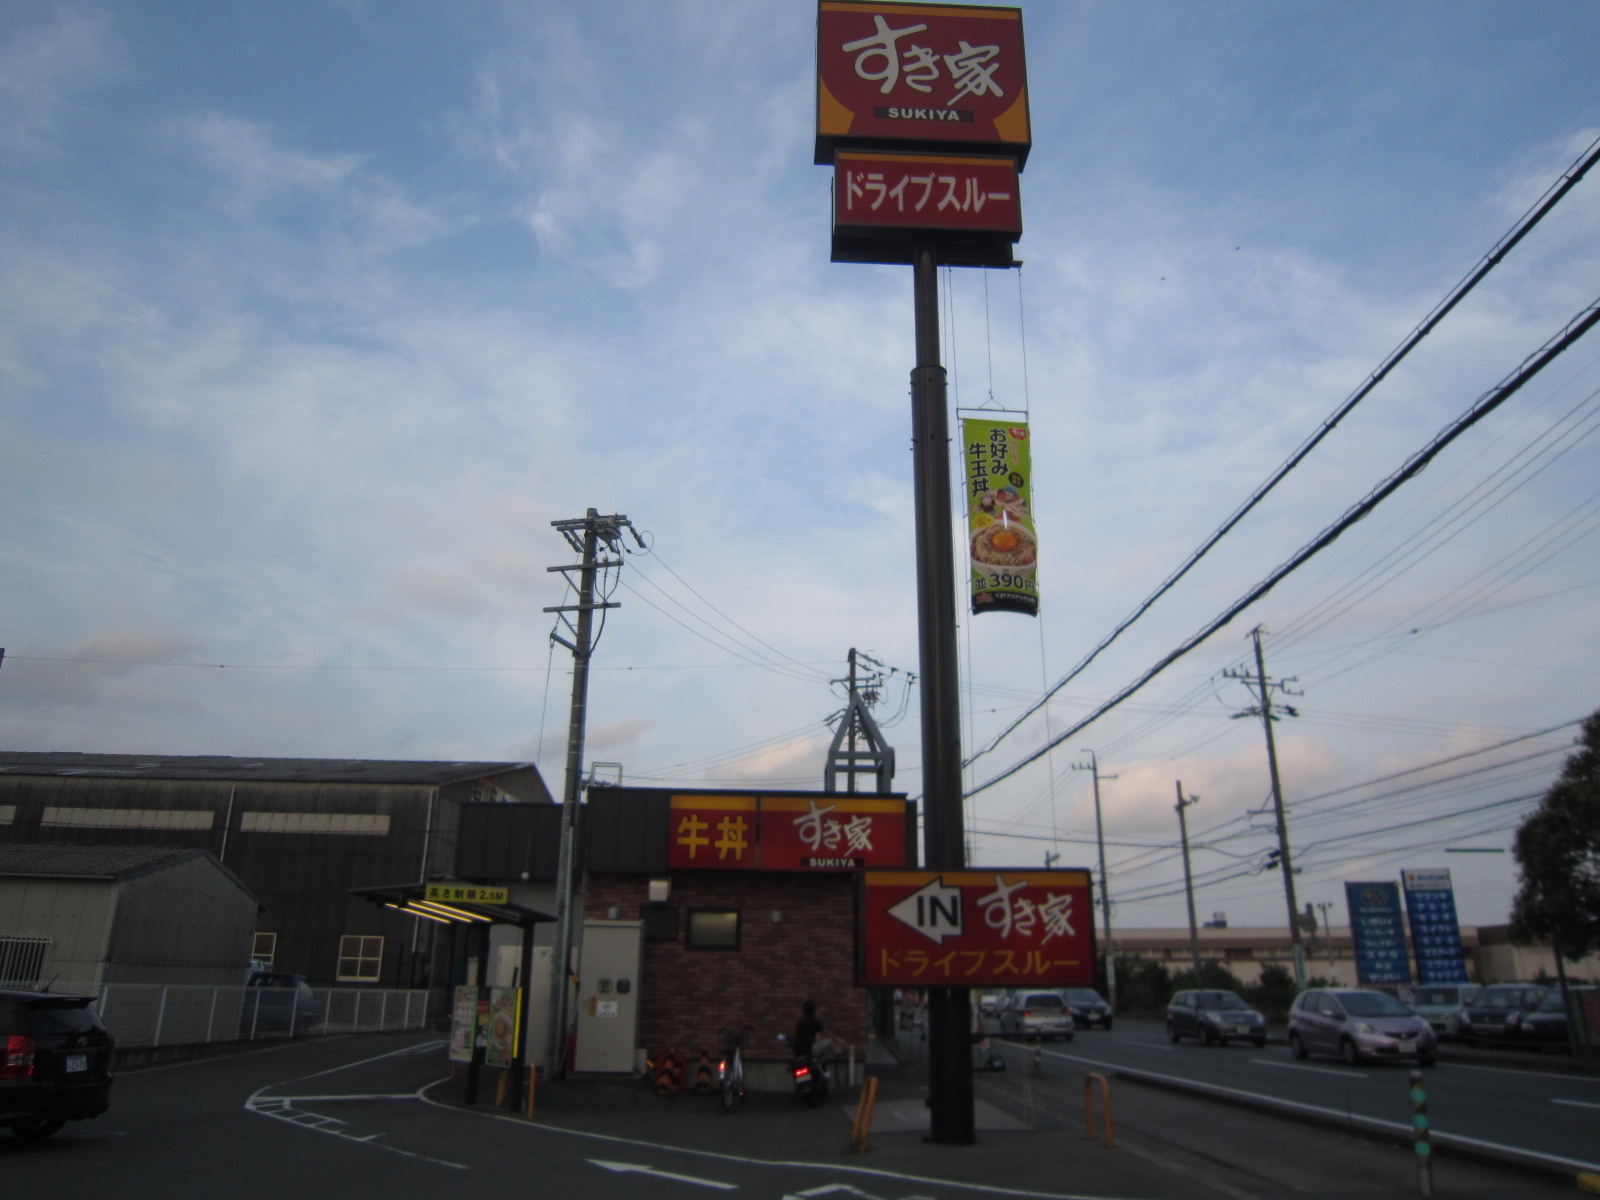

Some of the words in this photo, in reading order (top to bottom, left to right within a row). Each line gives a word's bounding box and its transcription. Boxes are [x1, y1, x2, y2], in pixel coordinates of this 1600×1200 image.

[841, 14, 1004, 107] すき家
[888, 107, 960, 121] SUKIYA
[846, 170, 1011, 213] ドライブスルー
[969, 442, 989, 498] 牛玉丼
[989, 428, 1009, 477] お好み
[677, 814, 749, 861] 牛丼
[792, 800, 873, 857] すき家
[809, 858, 856, 868] SUKIYA
[917, 895, 958, 927] IN
[976, 874, 1076, 946] すき家
